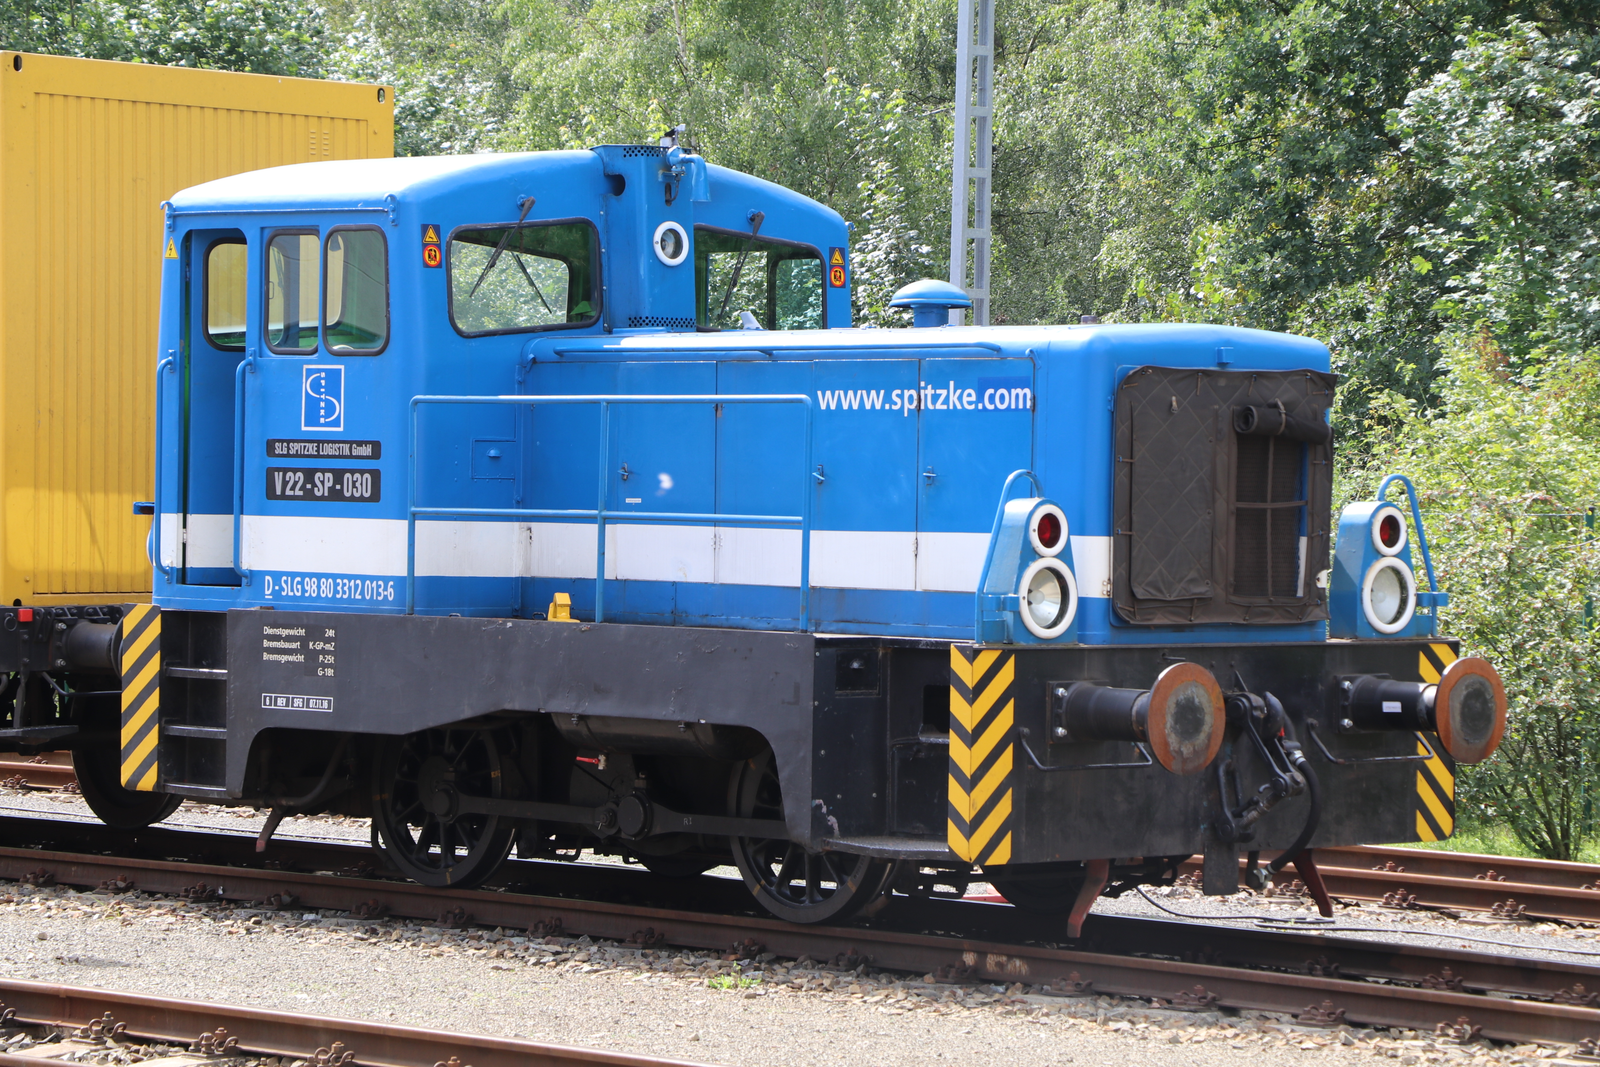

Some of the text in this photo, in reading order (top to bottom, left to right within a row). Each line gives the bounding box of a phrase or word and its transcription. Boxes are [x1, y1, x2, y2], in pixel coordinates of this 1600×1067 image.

[817, 380, 1032, 417] www.spitzke.com
[274, 442, 372, 456] SLG SPITZKE LOGISTIK GmbH
[304, 578, 318, 597] 98
[320, 578, 334, 598] 80
[336, 579, 362, 599] 3312
[364, 580, 394, 601] 013-6
[263, 626, 305, 637] Dienstgewicht
[263, 640, 335, 650] Bremsbauart K-GP-mZ
[263, 652, 334, 664] Bremsgewicht P-25t
[318, 668, 334, 676] G-18t
[277, 697, 286, 706] REV
